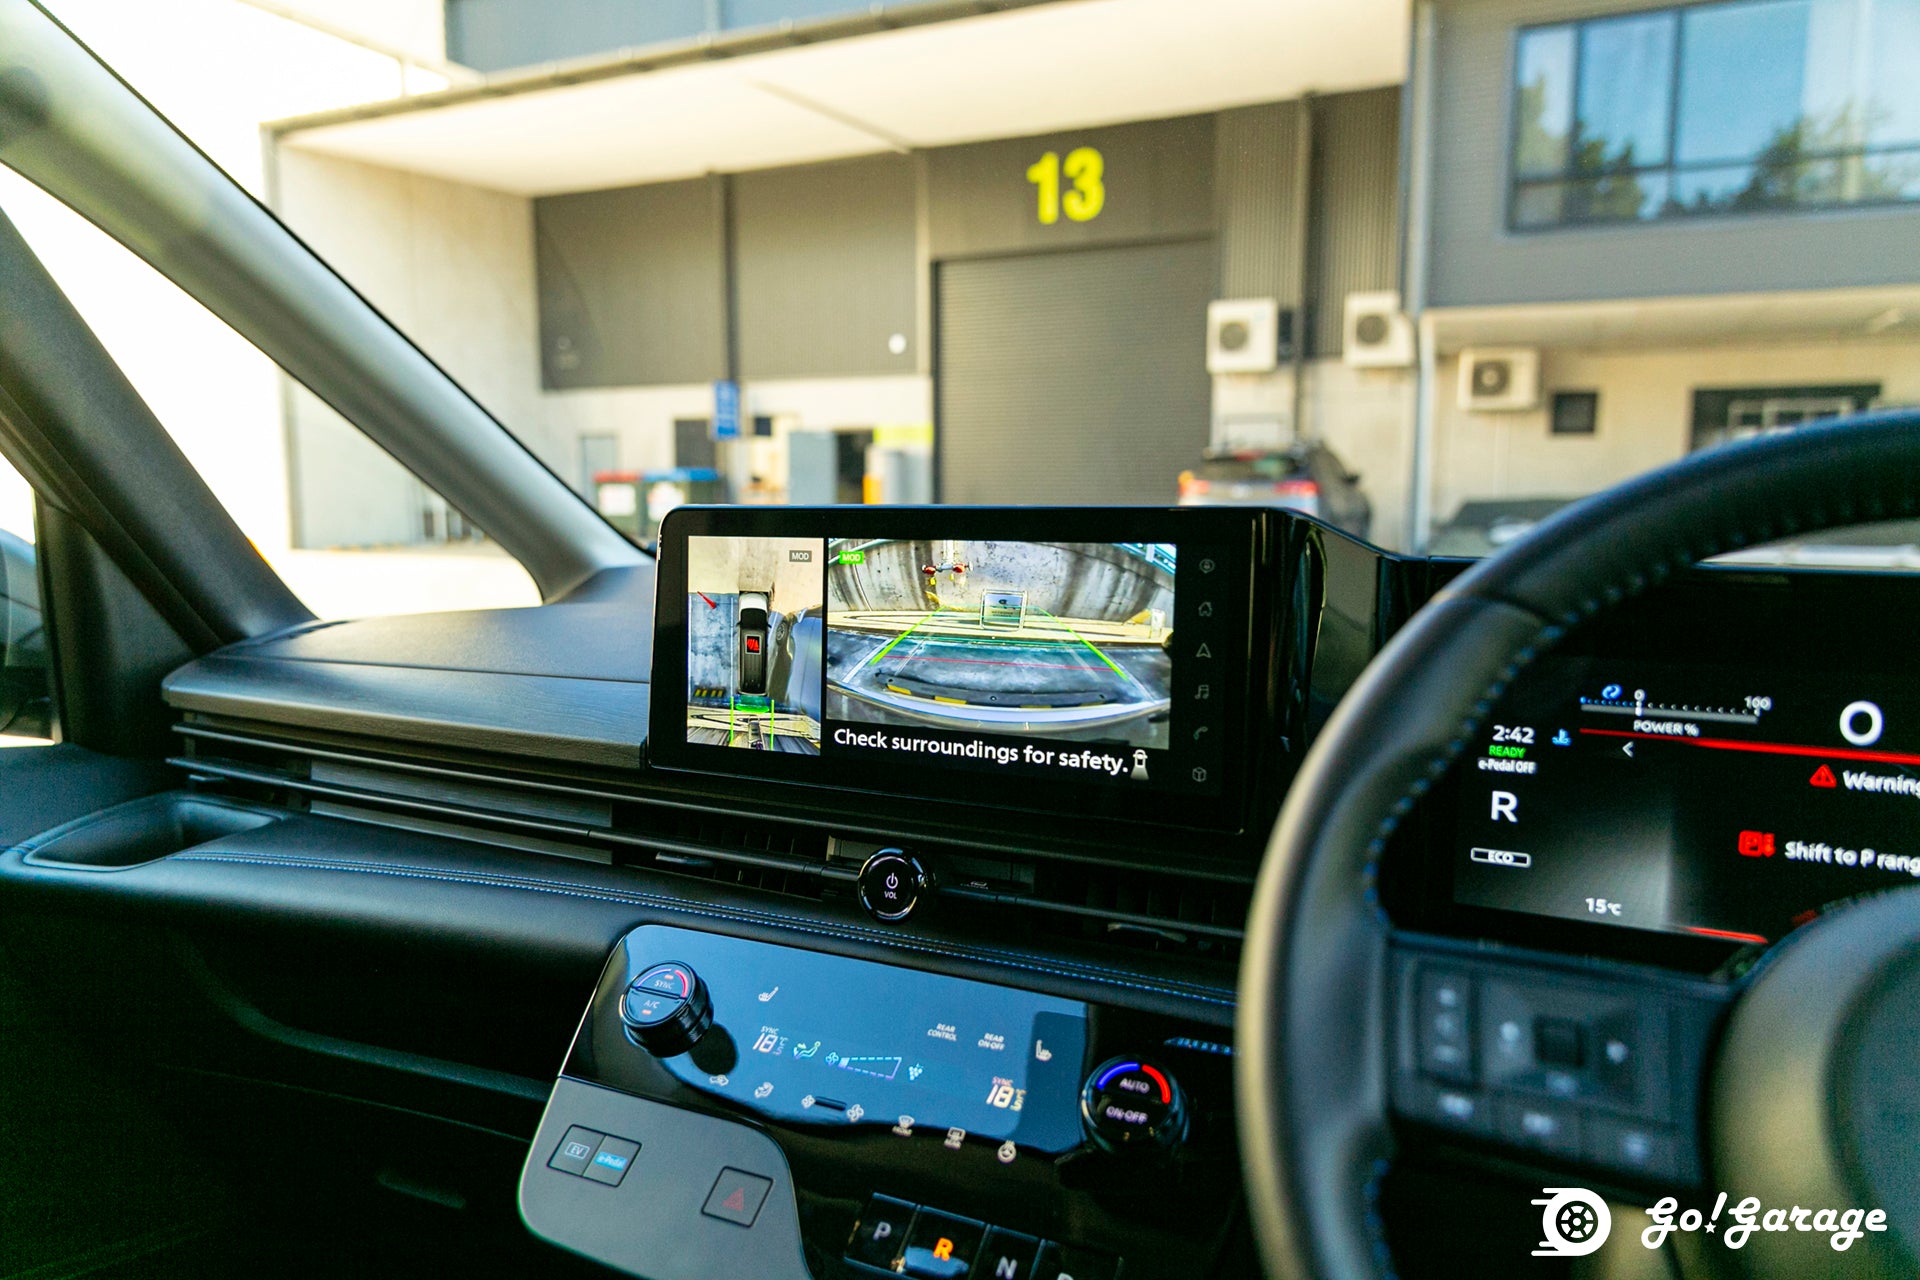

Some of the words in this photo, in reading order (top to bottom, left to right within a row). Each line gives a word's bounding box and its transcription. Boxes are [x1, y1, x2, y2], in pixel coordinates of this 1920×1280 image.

[1026, 146, 1105, 225] 13
[790, 552, 810, 561] MOD
[841, 553, 861, 562] MOD
[1744, 695, 1772, 711] 100
[1492, 724, 1535, 744] 2:42
[1633, 719, 1684, 735] POWER
[1684, 723, 1700, 737] %
[833, 728, 888, 749] Check
[891, 737, 1019, 764] surroundings
[1023, 745, 1056, 765] for
[1058, 750, 1129, 775] safety.
[1488, 744, 1527, 758] READY
[1478, 757, 1515, 772] e-Pedal
[1515, 760, 1537, 774] OFF
[1490, 790, 1519, 823] R
[1487, 850, 1515, 864] ECO
[1784, 841, 1833, 863] Shift
[1834, 847, 1858, 866] to
[1860, 848, 1876, 868] P
[884, 891, 897, 899] VOL
[654, 980, 674, 990] SYNC
[643, 1000, 660, 1009] A/C
[761, 1025, 779, 1035] SYNC
[927, 1029, 957, 1042] CONTROL
[936, 1023, 956, 1033] REAR
[984, 1033, 1005, 1043] REAR
[1119, 1078, 1150, 1094] AUTO
[570, 1145, 584, 1155] EV
[872, 1221, 892, 1241] P
[933, 1237, 954, 1262] R
[995, 1255, 1018, 1279] N
